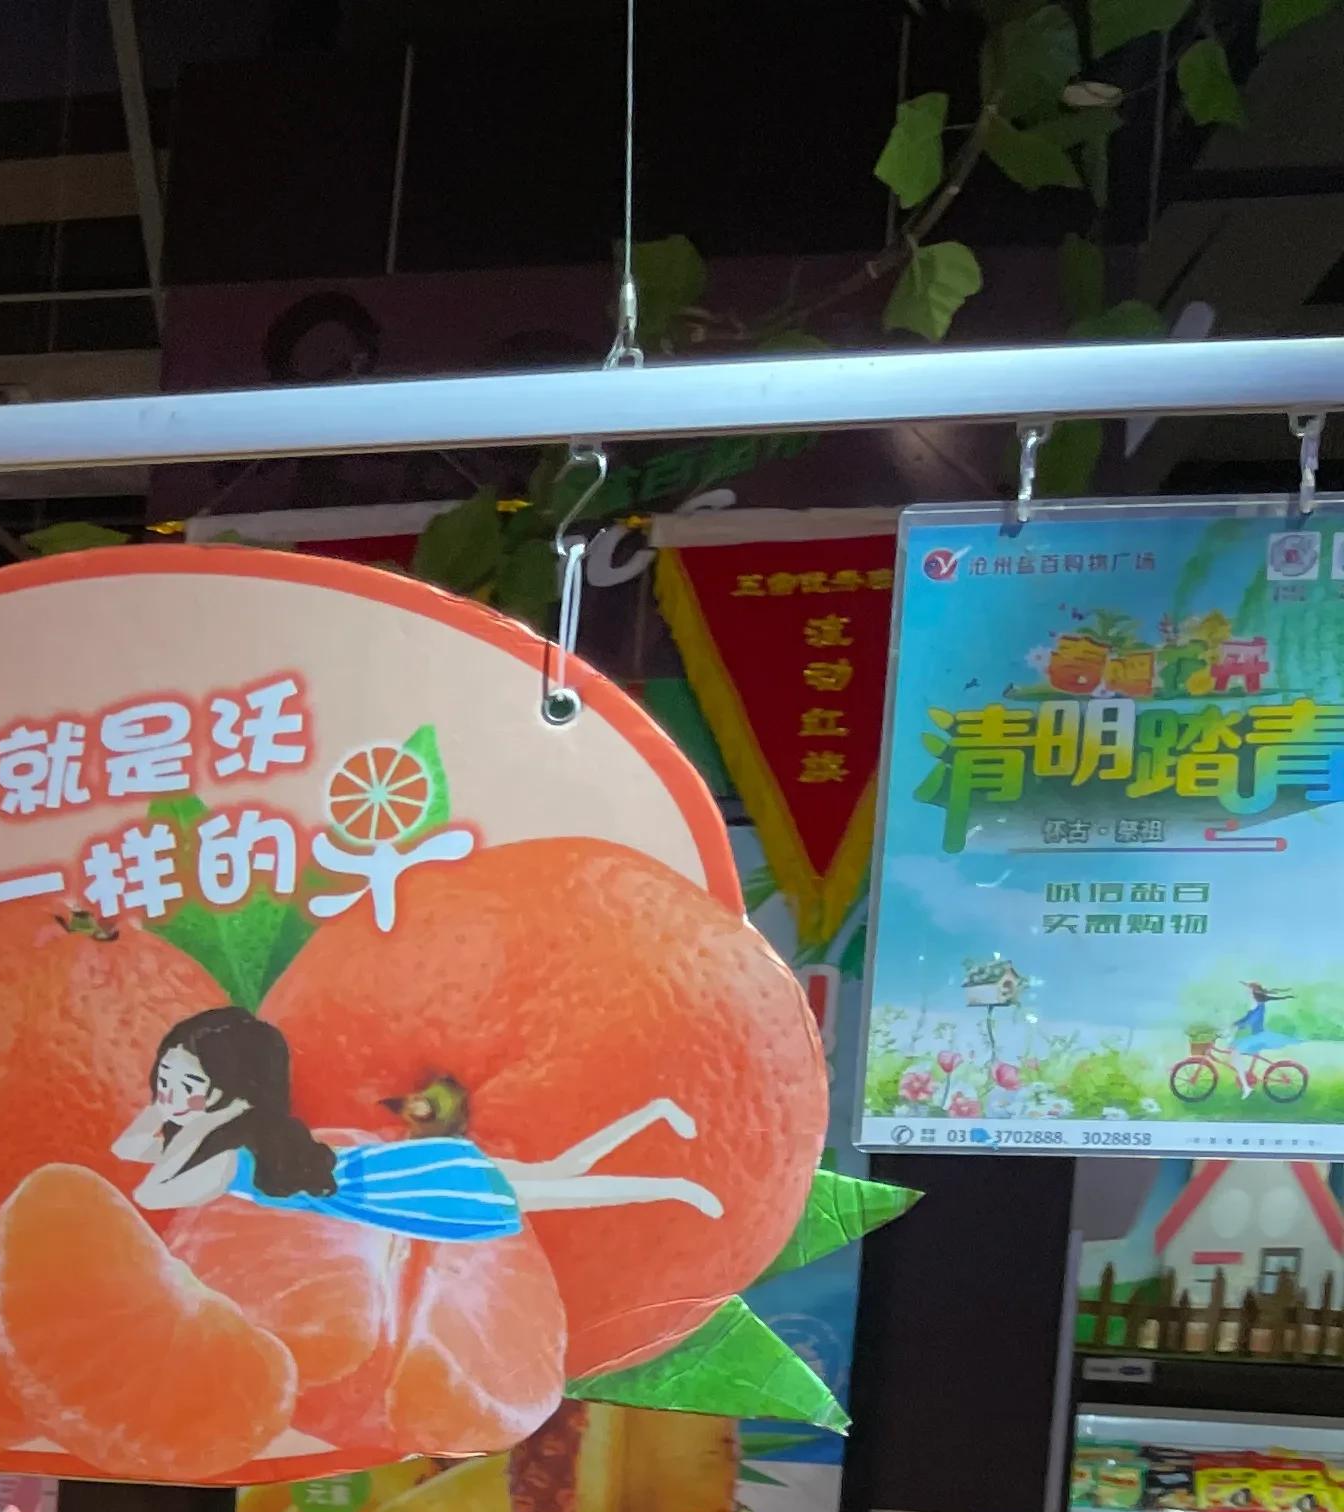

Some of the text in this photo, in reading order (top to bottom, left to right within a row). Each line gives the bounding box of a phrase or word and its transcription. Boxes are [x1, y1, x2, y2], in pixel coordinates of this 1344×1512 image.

[914, 698, 1344, 853] 清明踏青
[1042, 913, 1209, 935] 实惠购物
